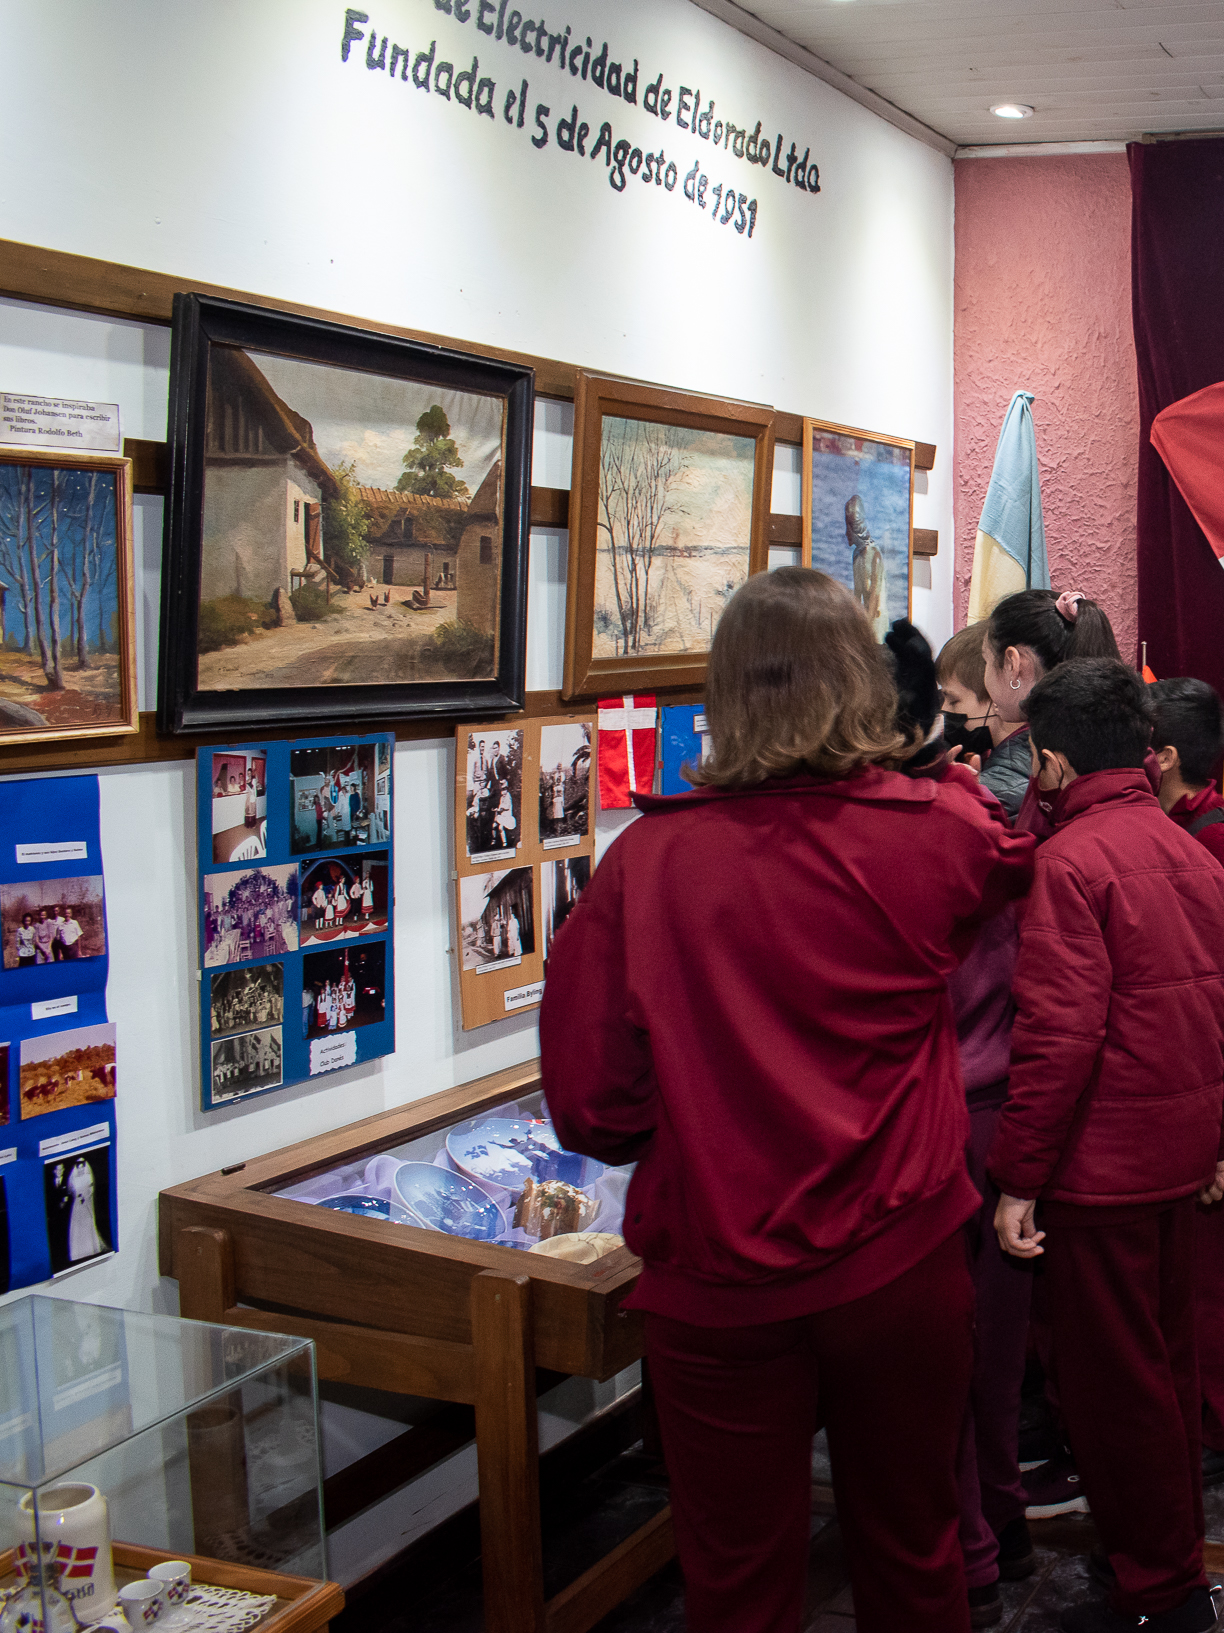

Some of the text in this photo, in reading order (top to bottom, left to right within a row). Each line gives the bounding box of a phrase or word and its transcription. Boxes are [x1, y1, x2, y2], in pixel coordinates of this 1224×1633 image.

[476, 0, 638, 106] Electricidad
[643, 73, 672, 120] de
[676, 86, 771, 168] Eldorado
[771, 133, 821, 194] Ltda
[341, 8, 758, 239] Fundada el 5 de Agosto de 1951
[28, 400, 52, 408] rancho
[62, 401, 95, 412] inspiraba
[34, 408, 66, 418] Johansen
[68, 412, 84, 421] para
[85, 413, 111, 422] escribir
[9, 424, 83, 438] Pintura Rodolfo Beth
